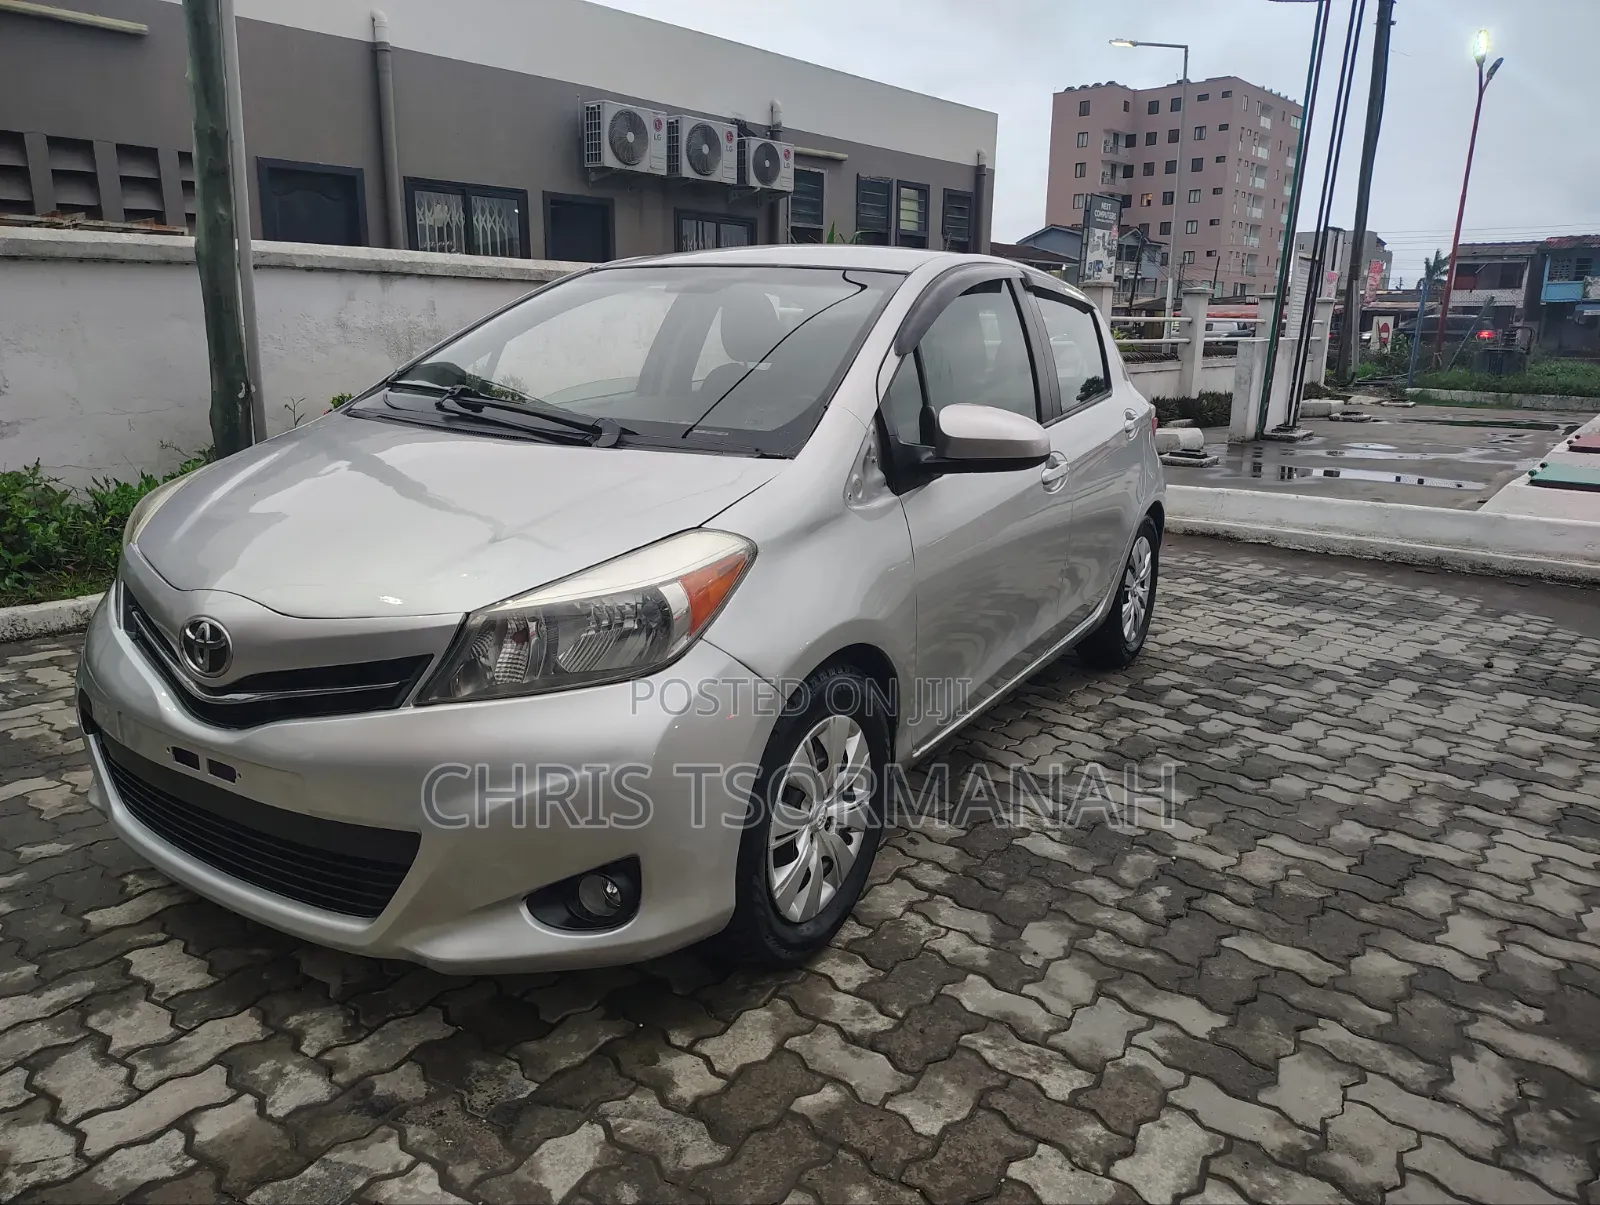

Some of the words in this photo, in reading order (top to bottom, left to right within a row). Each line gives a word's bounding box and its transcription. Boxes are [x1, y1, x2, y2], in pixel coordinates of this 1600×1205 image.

[653, 133, 662, 141] LG
[725, 144, 733, 153] LG
[783, 162, 791, 170] LG
